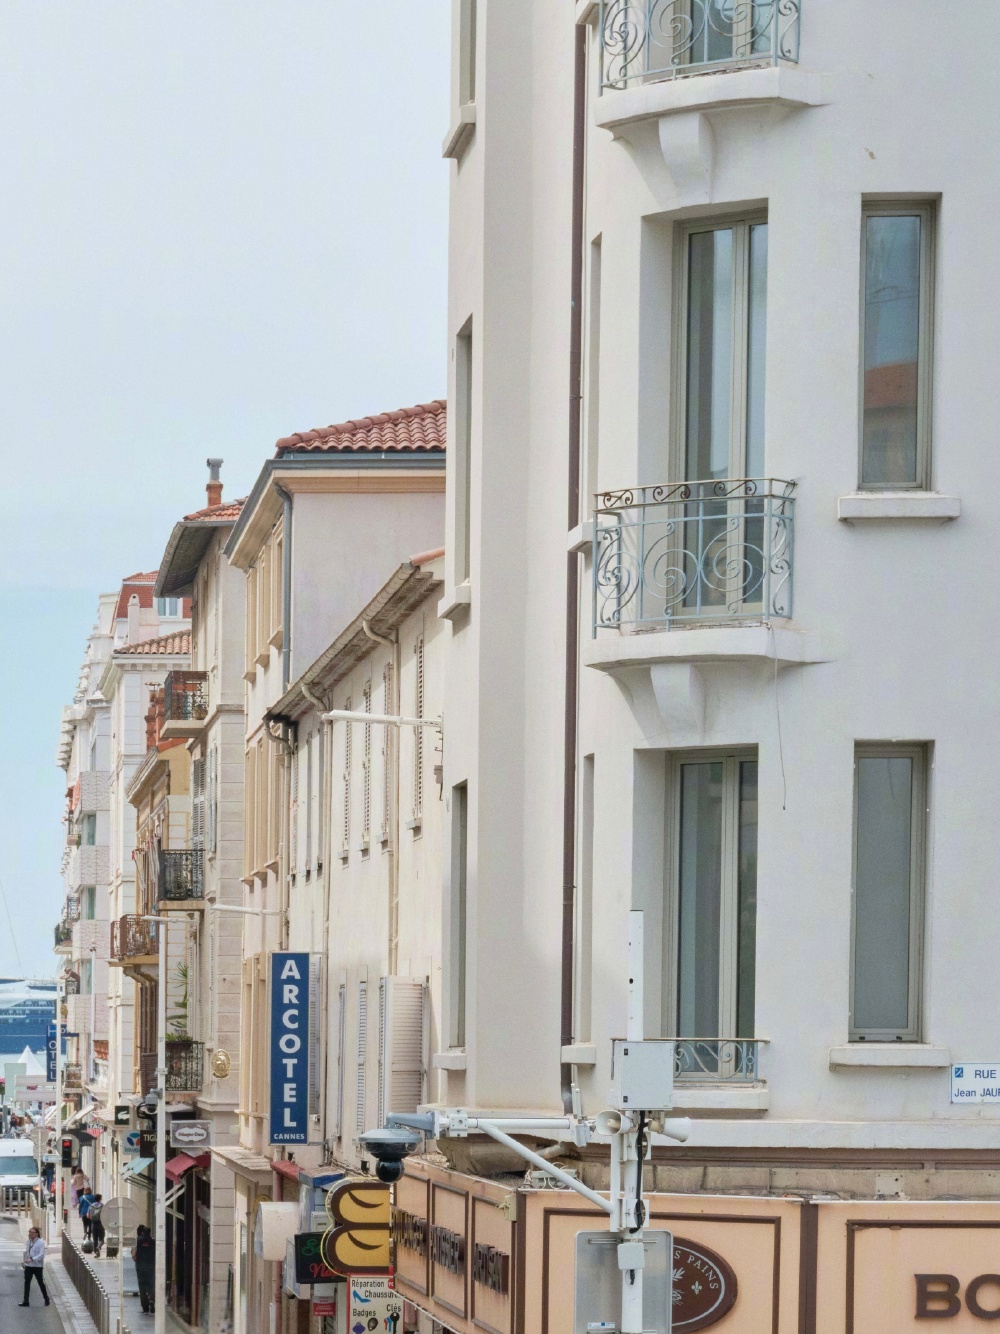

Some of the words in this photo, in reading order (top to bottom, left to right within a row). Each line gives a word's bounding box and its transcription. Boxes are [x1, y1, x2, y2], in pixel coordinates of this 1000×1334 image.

[279, 959, 301, 1128] ARCOTEL
[974, 1069, 997, 1079] RUE
[954, 1088, 977, 1097] Jean
[686, 1256, 719, 1290] PAINS
[351, 1279, 385, 1290] Réparation
[364, 1290, 400, 1298] Chaussure
[386, 1303, 402, 1312] Clés
[352, 1308, 377, 1318] Badges
